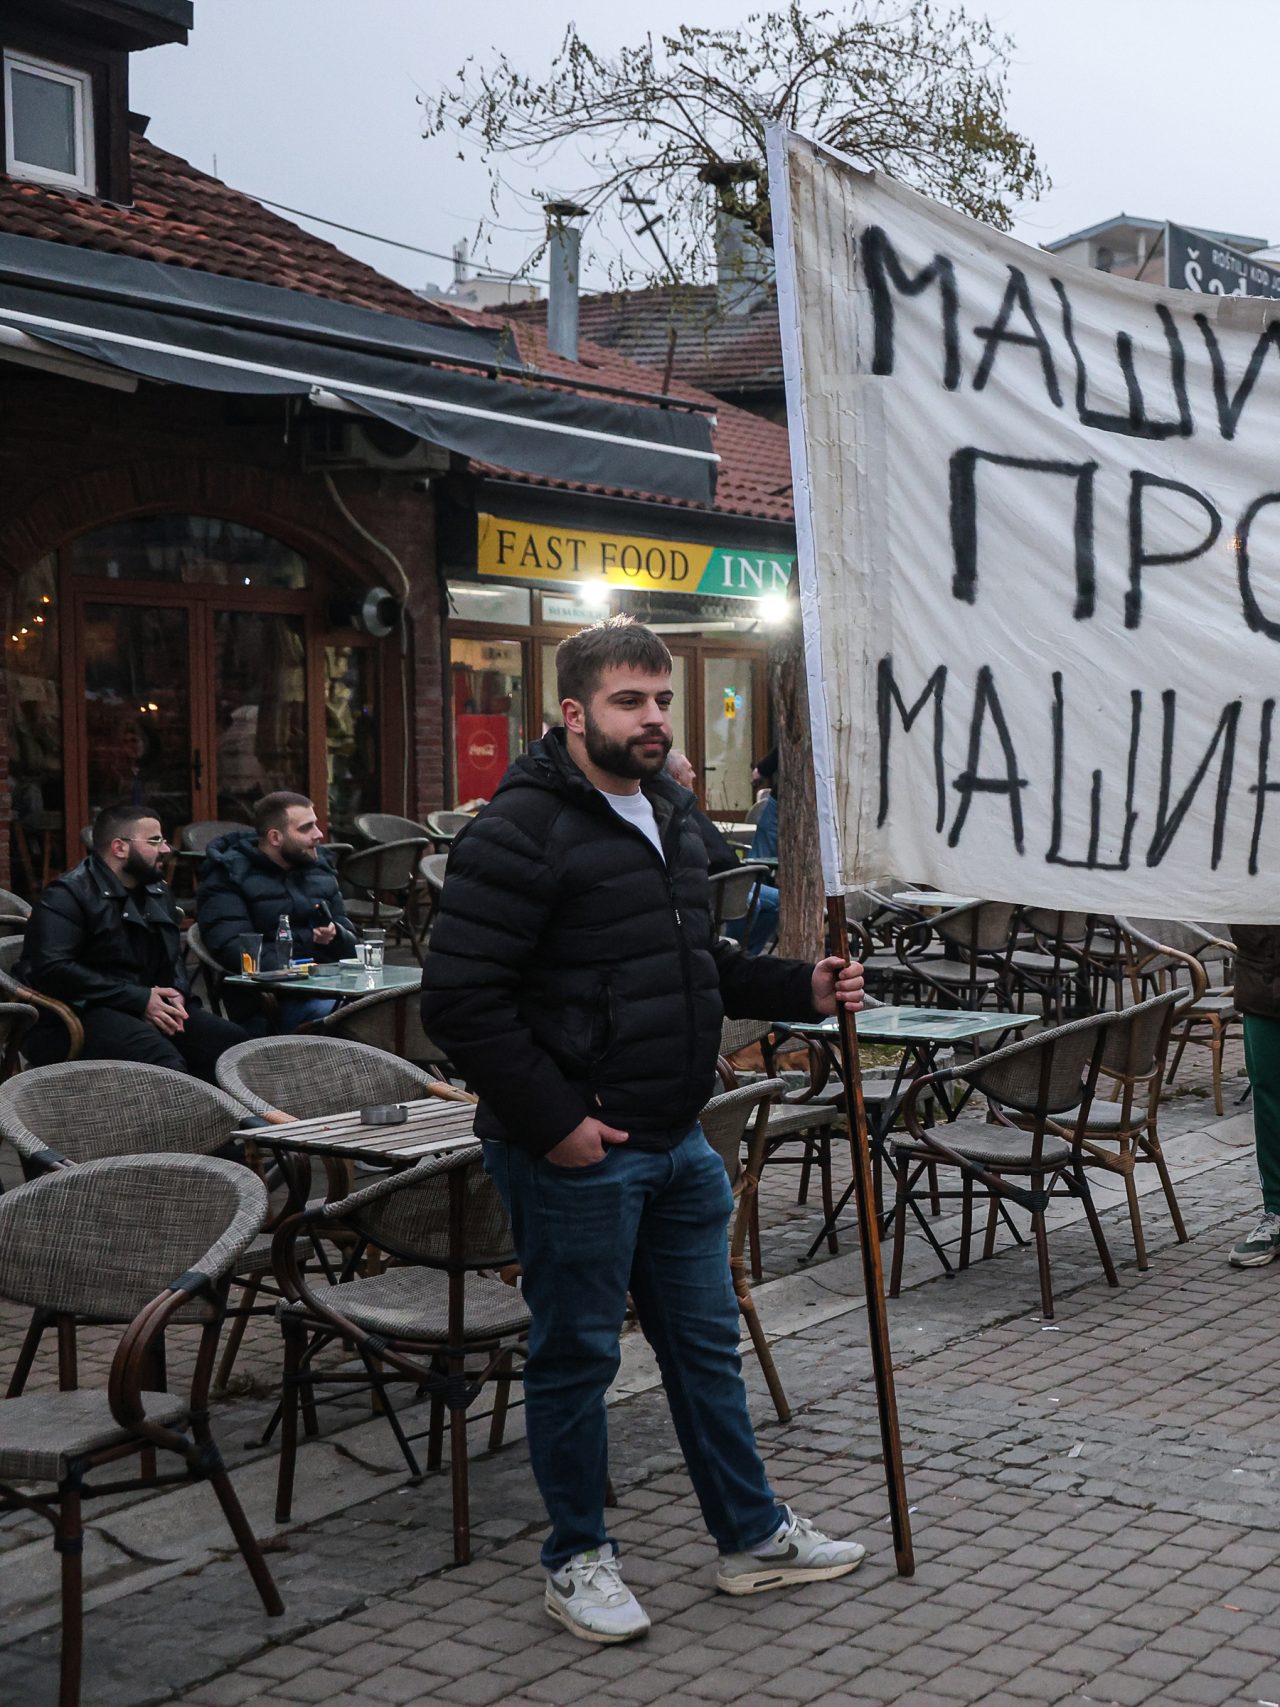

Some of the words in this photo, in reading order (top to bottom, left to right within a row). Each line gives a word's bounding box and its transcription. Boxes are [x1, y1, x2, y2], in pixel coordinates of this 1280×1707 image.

[496, 529, 587, 572] FAST
[601, 542, 690, 581] FOOD
[721, 555, 793, 591] INN
